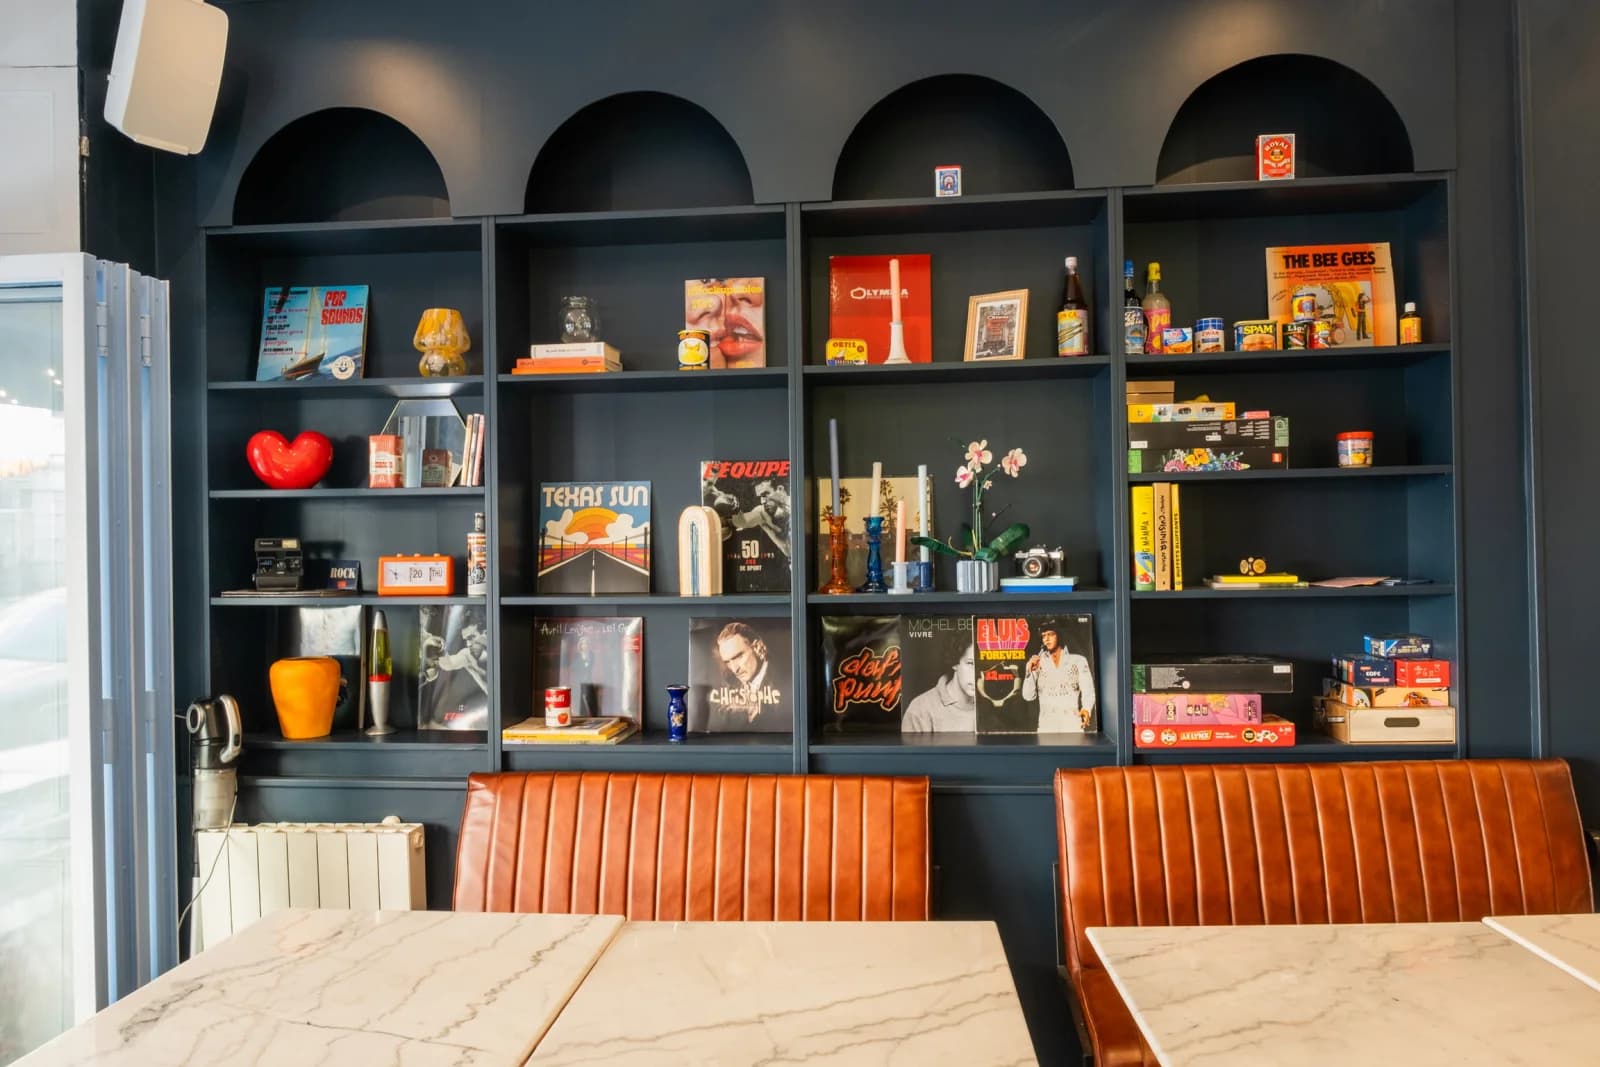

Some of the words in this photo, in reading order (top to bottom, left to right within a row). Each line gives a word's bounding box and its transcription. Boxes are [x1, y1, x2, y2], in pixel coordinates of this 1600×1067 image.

[1264, 140, 1289, 151] ROYAL
[1282, 254, 1310, 269] THE
[1312, 252, 1339, 268] BEE
[1341, 251, 1376, 266] GEES
[324, 290, 347, 307] POP
[850, 286, 909, 299] OLYMA
[321, 308, 364, 325] SOUNDS
[1243, 324, 1273, 335] SPAM
[703, 460, 791, 479] L'EQUIPE
[542, 486, 604, 507] TEXAS
[609, 486, 648, 506] SUN
[741, 540, 759, 558] 50
[330, 567, 357, 579] ROCK
[413, 569, 423, 578] 20
[908, 619, 954, 630] MICHEL
[957, 619, 972, 630] BE
[977, 618, 1030, 646] ELVIS
[980, 650, 1026, 660] FOREVER
